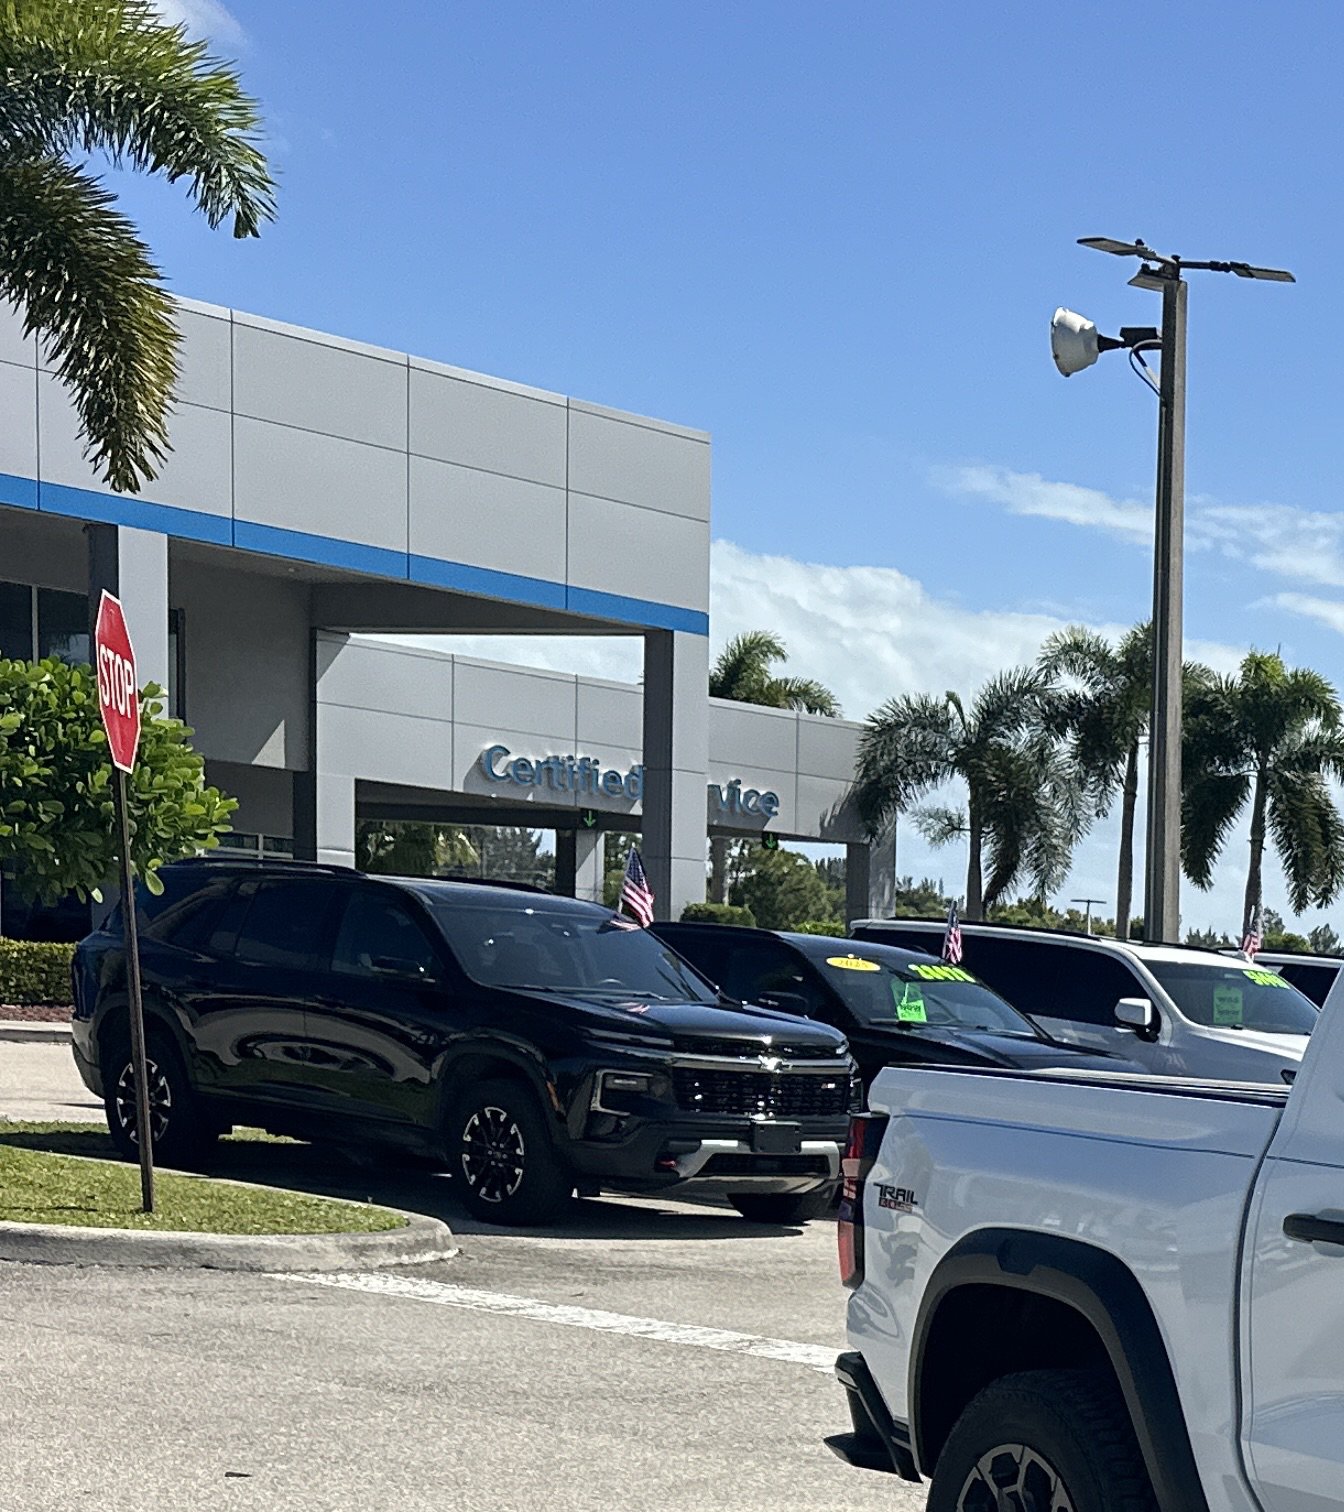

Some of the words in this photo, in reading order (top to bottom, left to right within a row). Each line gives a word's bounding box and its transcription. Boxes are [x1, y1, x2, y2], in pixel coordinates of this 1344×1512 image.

[100, 643, 134, 719] STOP
[484, 744, 644, 801] Certified
[707, 779, 779, 818] vice
[873, 1182, 918, 1205] TRAIL
